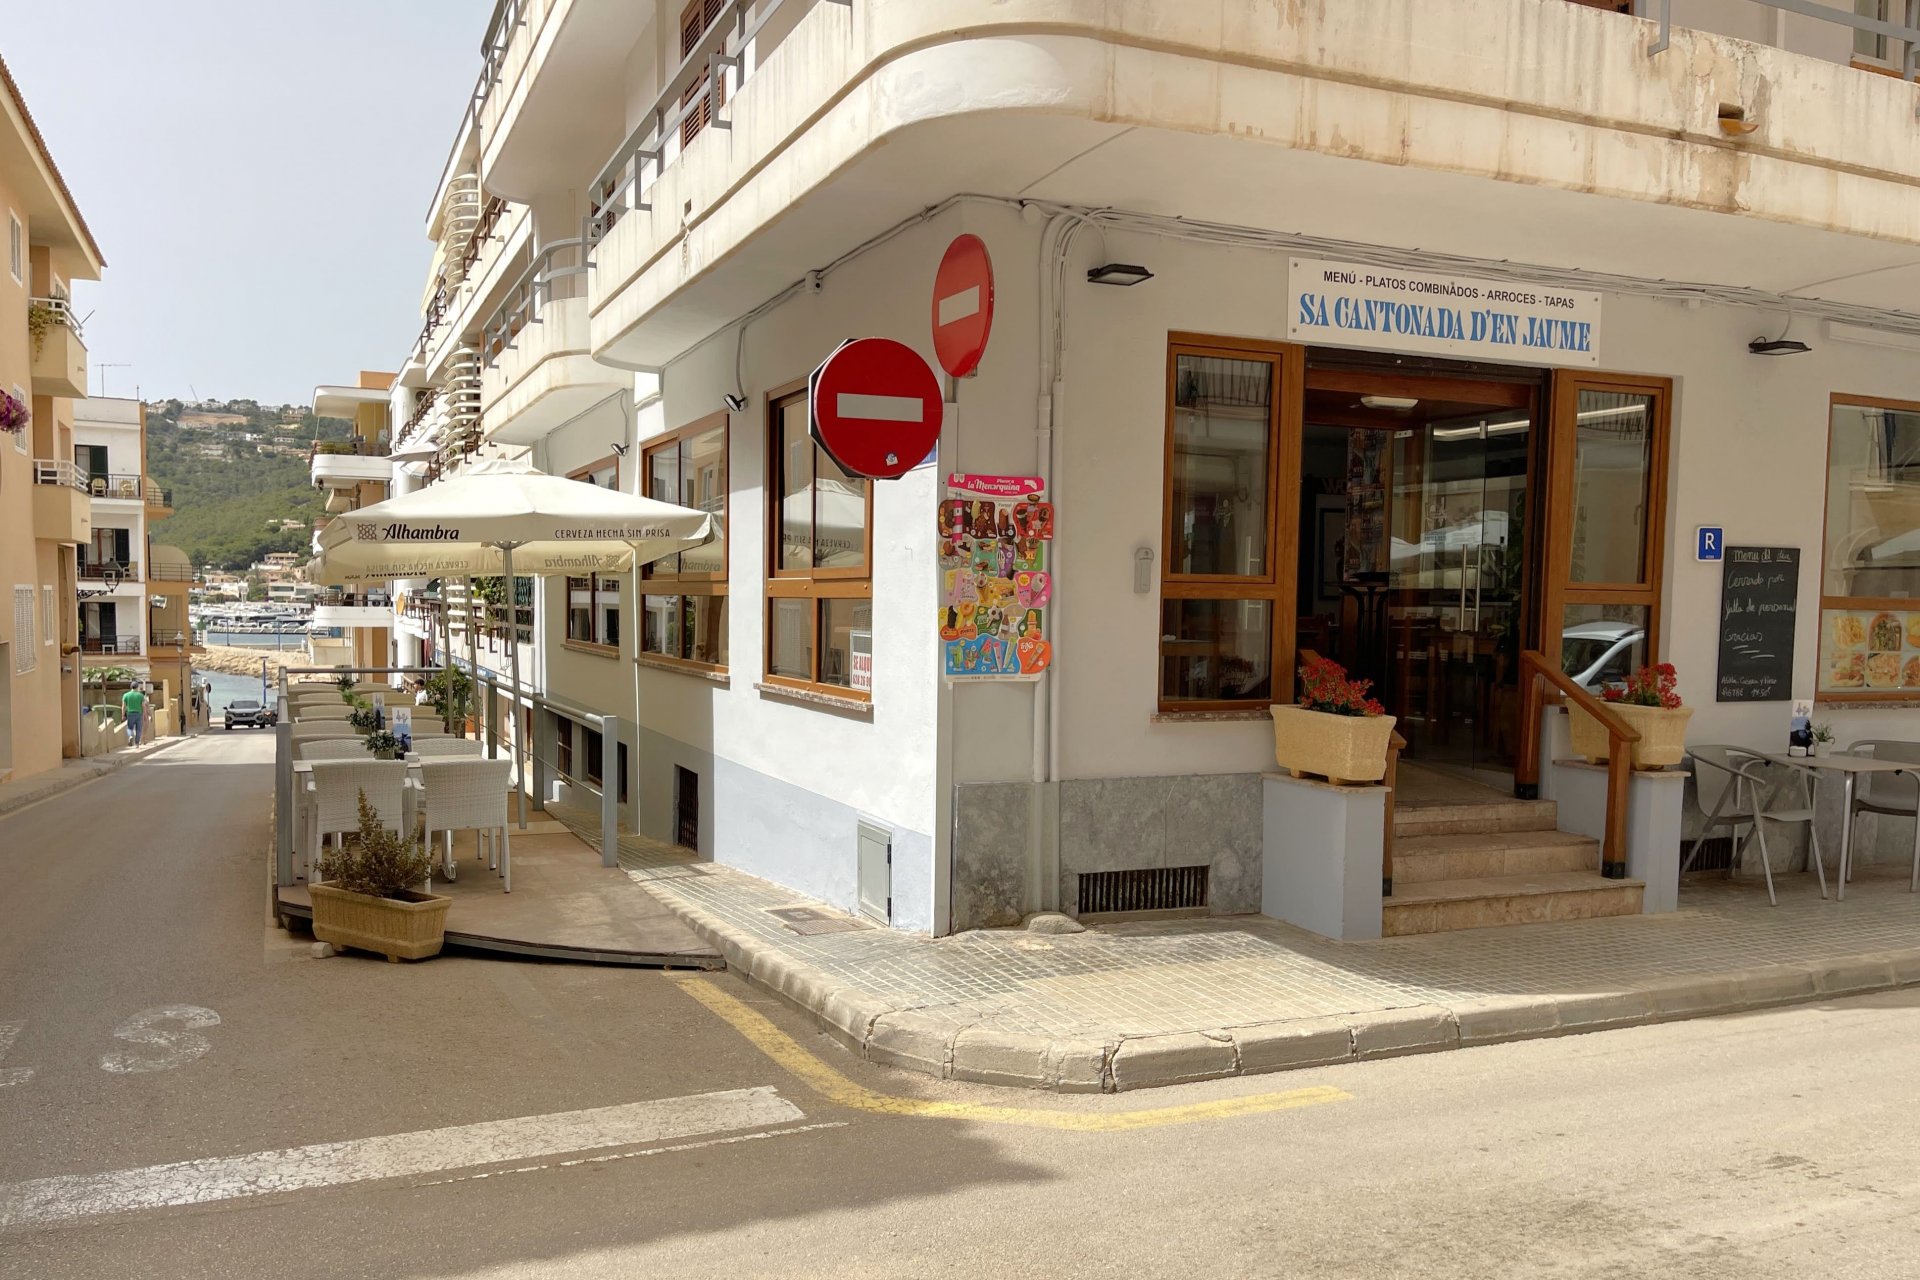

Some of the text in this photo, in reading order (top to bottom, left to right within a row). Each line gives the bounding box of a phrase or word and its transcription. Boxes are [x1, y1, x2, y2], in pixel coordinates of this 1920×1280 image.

[1323, 270, 1356, 285] MENÚ
[1365, 275, 1406, 291] PLATOS
[1409, 281, 1479, 299] COMBINADOS
[1487, 289, 1536, 306] ARROCES
[1544, 296, 1575, 309] TAPAS
[1300, 293, 1330, 327] SA
[1334, 296, 1465, 341] CANTONADA
[1522, 317, 1591, 352] JAUME
[382, 523, 459, 540] Alhambra
[555, 528, 670, 539] CERVEZA HECHA SIN PRISA
[1705, 532, 1715, 550] R
